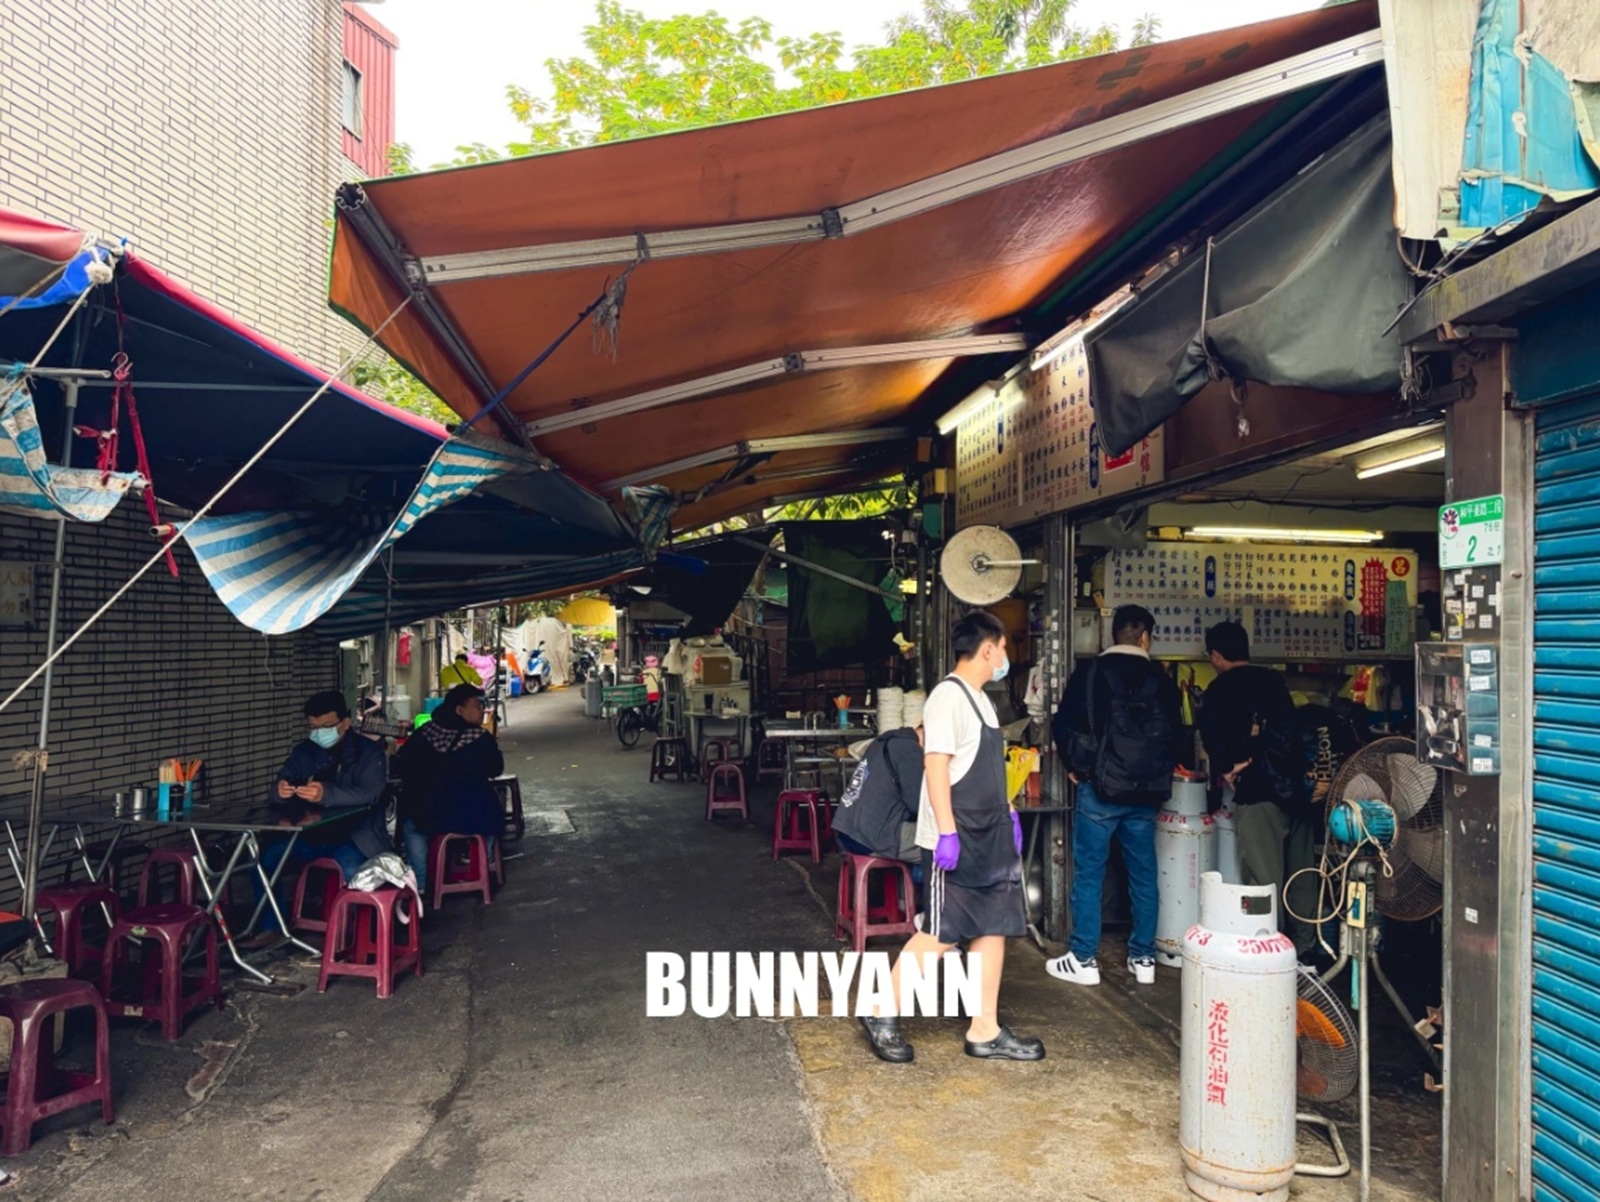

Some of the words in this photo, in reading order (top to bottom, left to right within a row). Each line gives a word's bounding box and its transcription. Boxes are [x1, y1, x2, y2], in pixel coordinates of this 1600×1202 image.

[1466, 535, 1478, 562] 2
[1316, 725, 1332, 782] NORTH
[1206, 998, 1230, 1107] 液化石油氣
